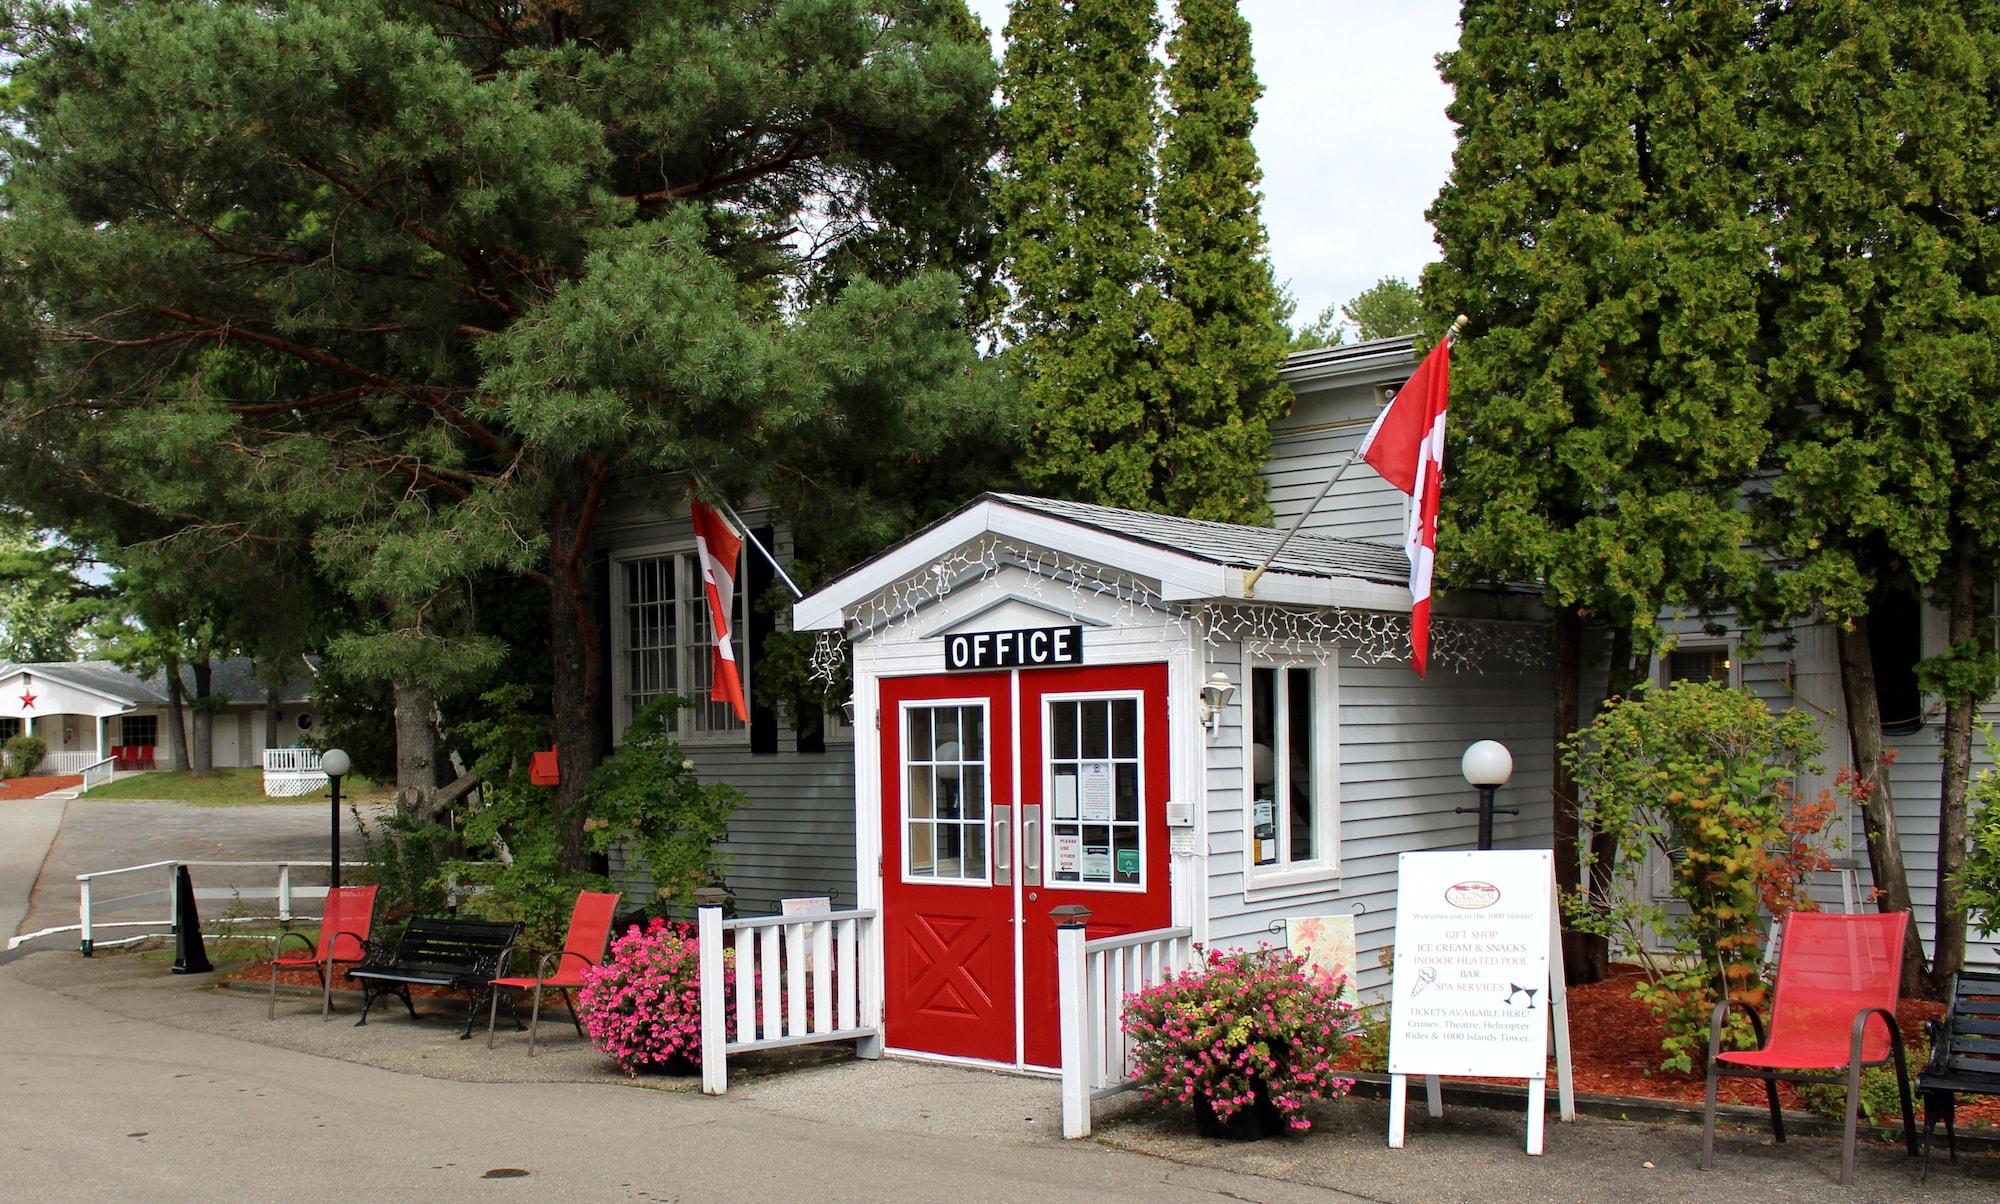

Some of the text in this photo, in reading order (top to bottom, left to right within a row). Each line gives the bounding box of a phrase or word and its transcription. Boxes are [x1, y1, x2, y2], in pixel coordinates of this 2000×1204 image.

[952, 628, 1072, 668] OFFICE
[1473, 912, 1485, 920] the
[1488, 912, 1505, 920] 1000
[1445, 930, 1498, 939] GIFT SHOP
[1417, 943, 1527, 953] ICE CREAM & SNACKS
[1414, 956, 1528, 966] INDOOR HEATED POOL
[1460, 969, 1480, 978] BAR
[1435, 982, 1504, 992] SPA SERVICES
[1409, 1007, 1530, 1018] TICKETS AVAILABLE HERE!
[1407, 1019, 1530, 1031] Cruises, Theatre, Helicopter
[1405, 1031, 1429, 1040] Rides
[1431, 1032, 1439, 1040] &
[1443, 1032, 1465, 1041] 1000
[1467, 1033, 1497, 1041] Islands
